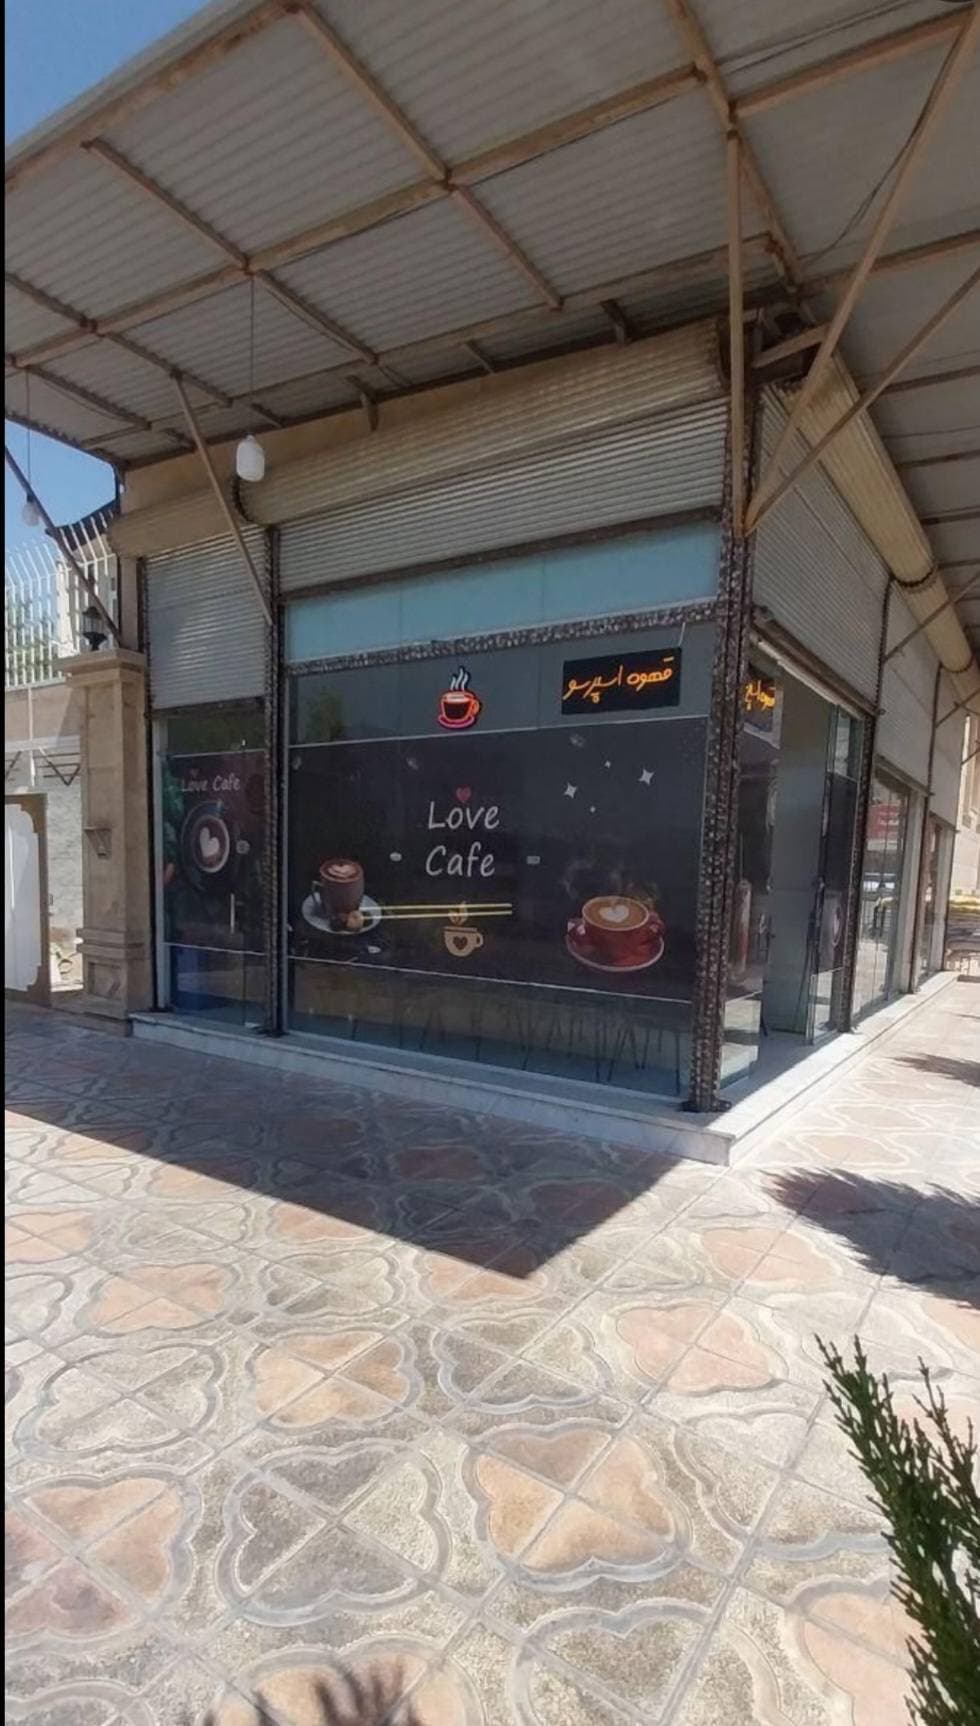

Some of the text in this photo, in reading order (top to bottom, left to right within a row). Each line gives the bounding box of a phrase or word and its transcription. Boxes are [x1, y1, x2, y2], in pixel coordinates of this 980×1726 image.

[562, 656, 674, 704] قهوه اسپرسو
[181, 772, 241, 792] Love Cafe
[427, 801, 500, 830] Love
[425, 841, 496, 877] Cafe
